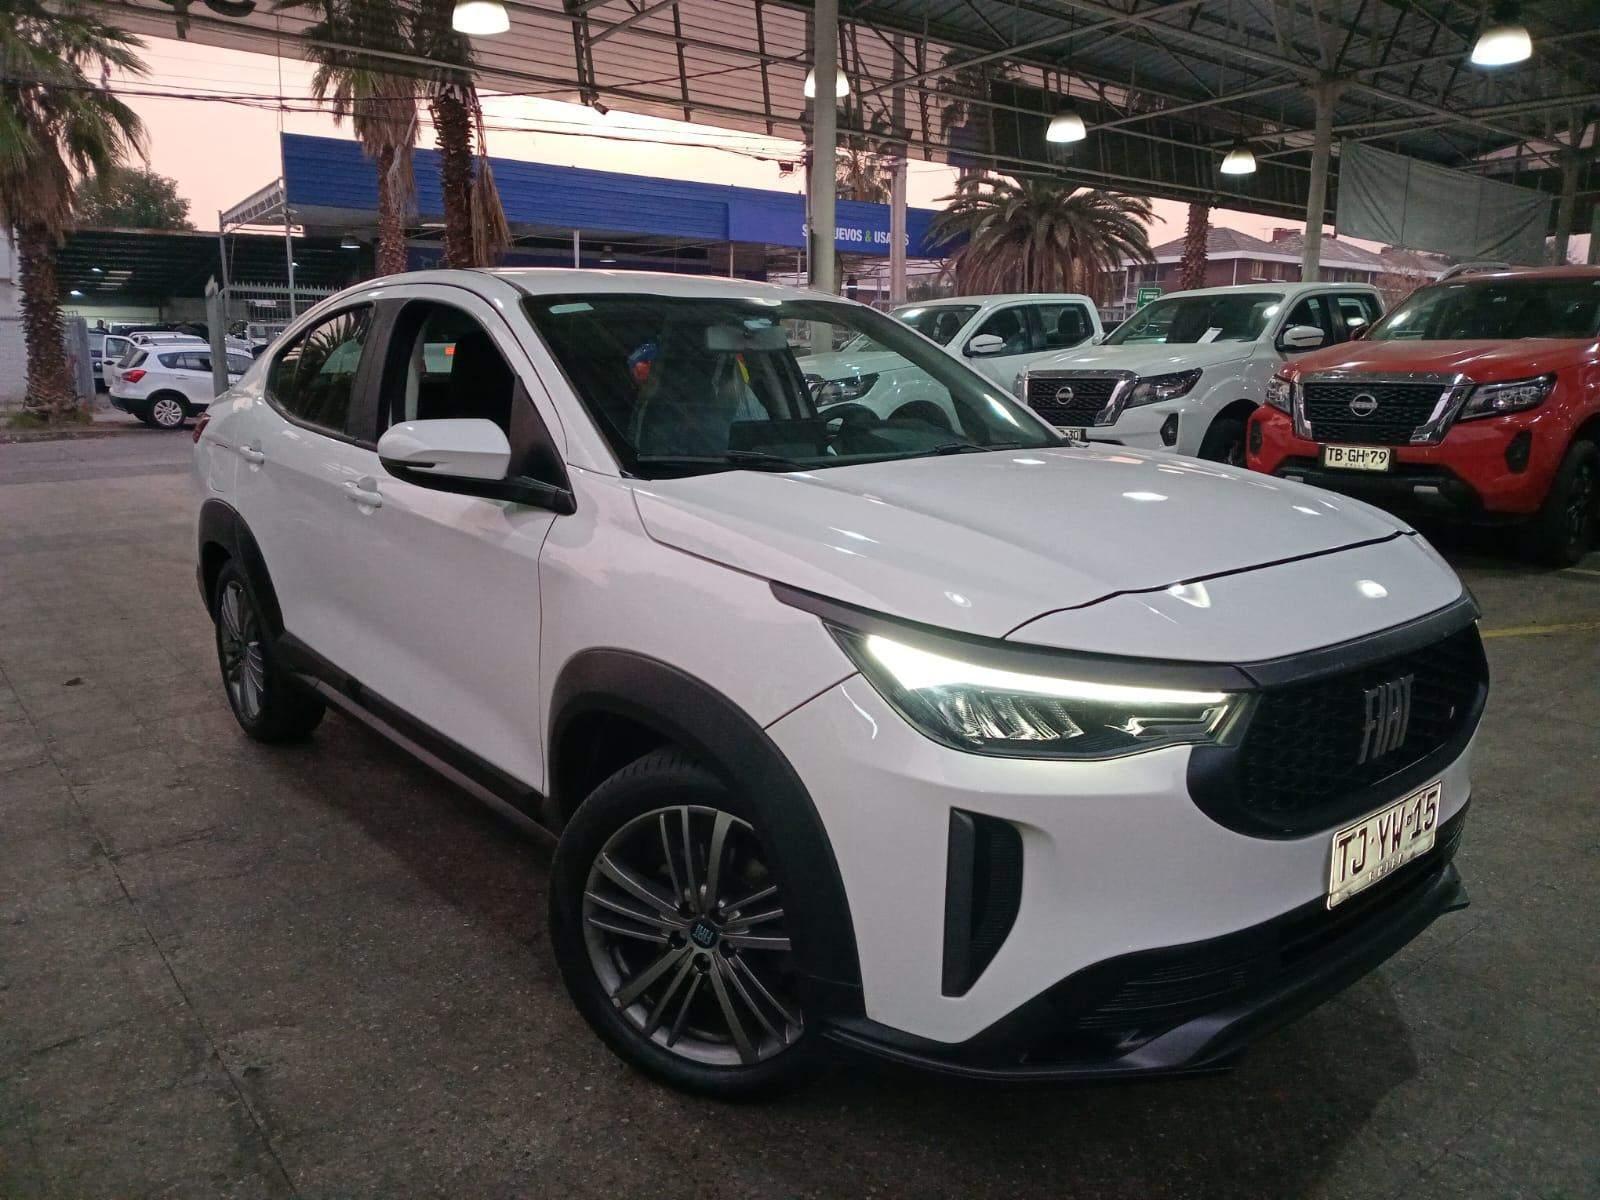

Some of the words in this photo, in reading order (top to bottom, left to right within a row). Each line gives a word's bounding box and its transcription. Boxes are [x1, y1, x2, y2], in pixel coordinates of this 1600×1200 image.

[865, 230, 873, 243] &
[874, 231, 909, 246] USAS
[1358, 674, 1414, 764] FIAT
